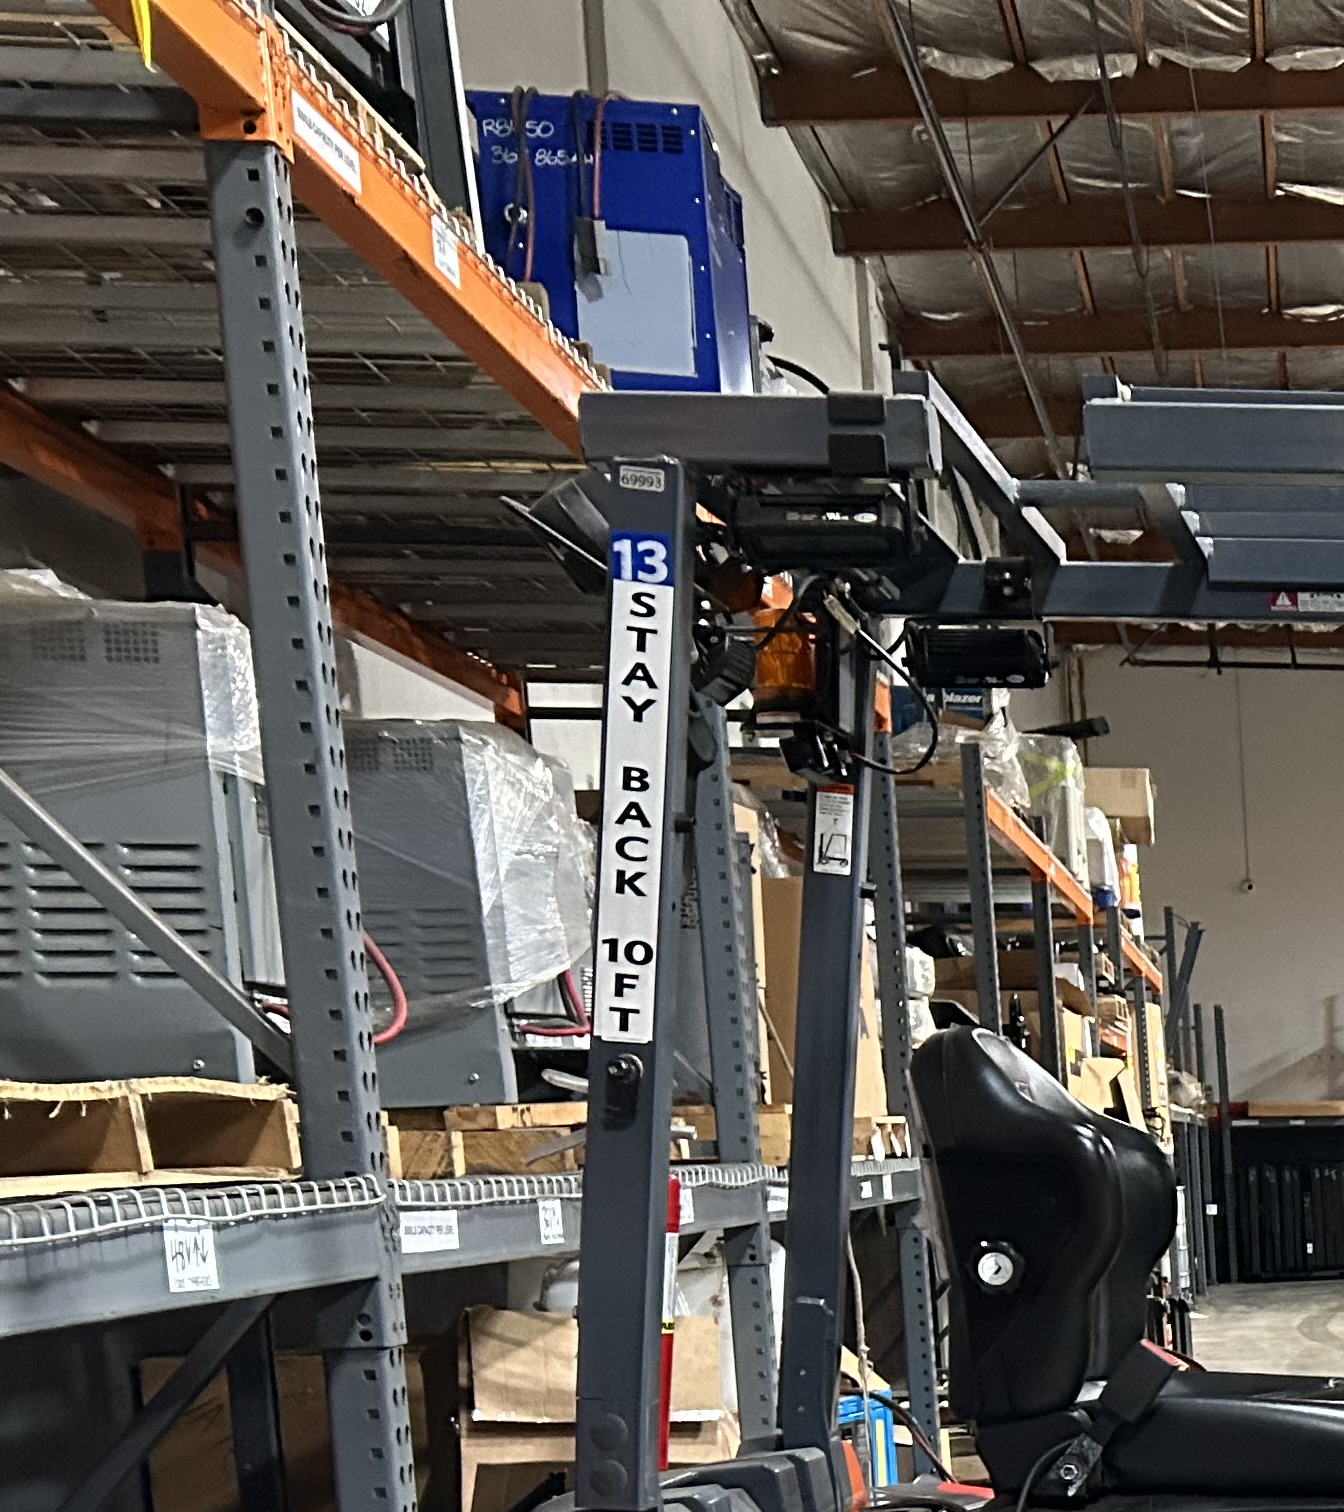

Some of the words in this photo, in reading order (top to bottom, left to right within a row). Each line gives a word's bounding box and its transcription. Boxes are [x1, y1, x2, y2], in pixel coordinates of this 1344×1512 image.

[621, 474, 662, 489] 69993
[613, 539, 669, 584] 13
[622, 591, 658, 724] STAY
[614, 766, 653, 898] BACK
